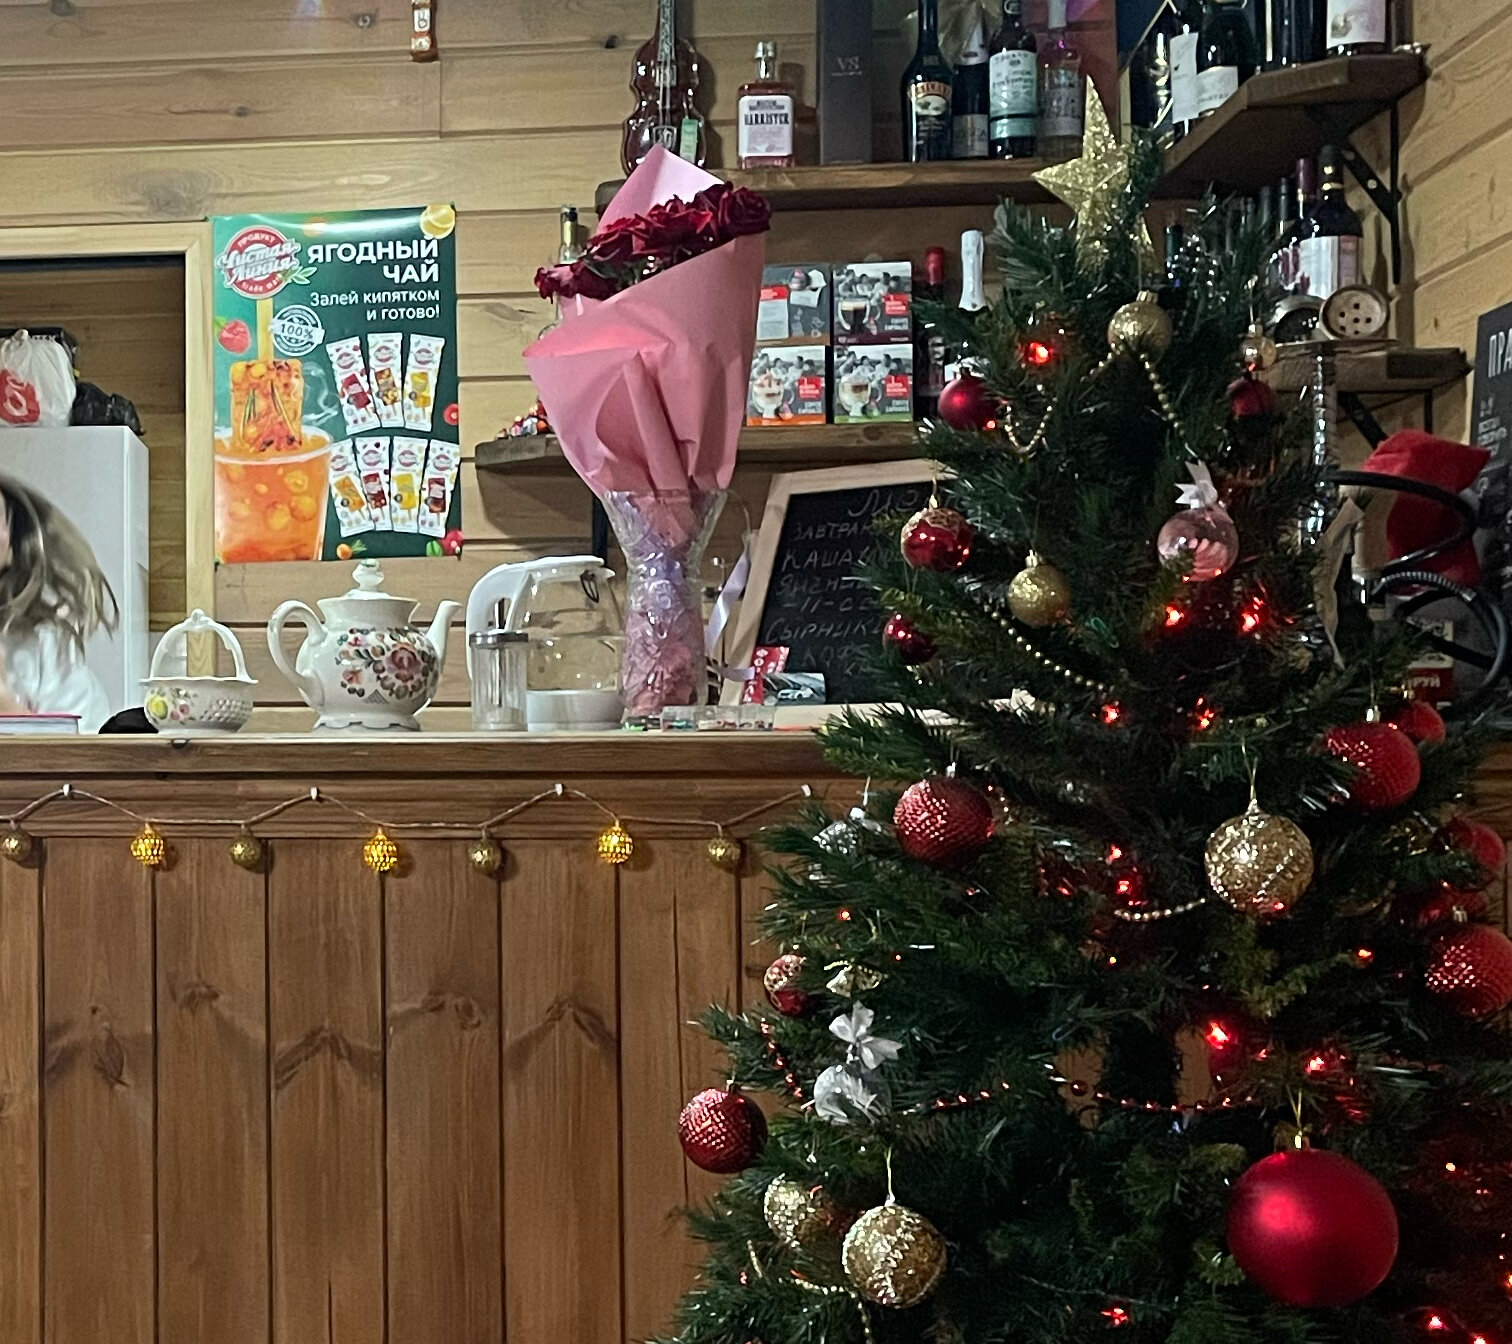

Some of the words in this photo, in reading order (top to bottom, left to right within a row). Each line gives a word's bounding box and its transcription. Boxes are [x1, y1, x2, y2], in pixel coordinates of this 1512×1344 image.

[307, 236, 439, 265] ЯГОДНЫЙ
[382, 259, 439, 284] ЧАЙ
[310, 290, 359, 307] Залей
[363, 289, 440, 304] кипятком
[366, 309, 377, 321] и
[381, 304, 440, 320] готово!
[281, 324, 314, 339] 100%
